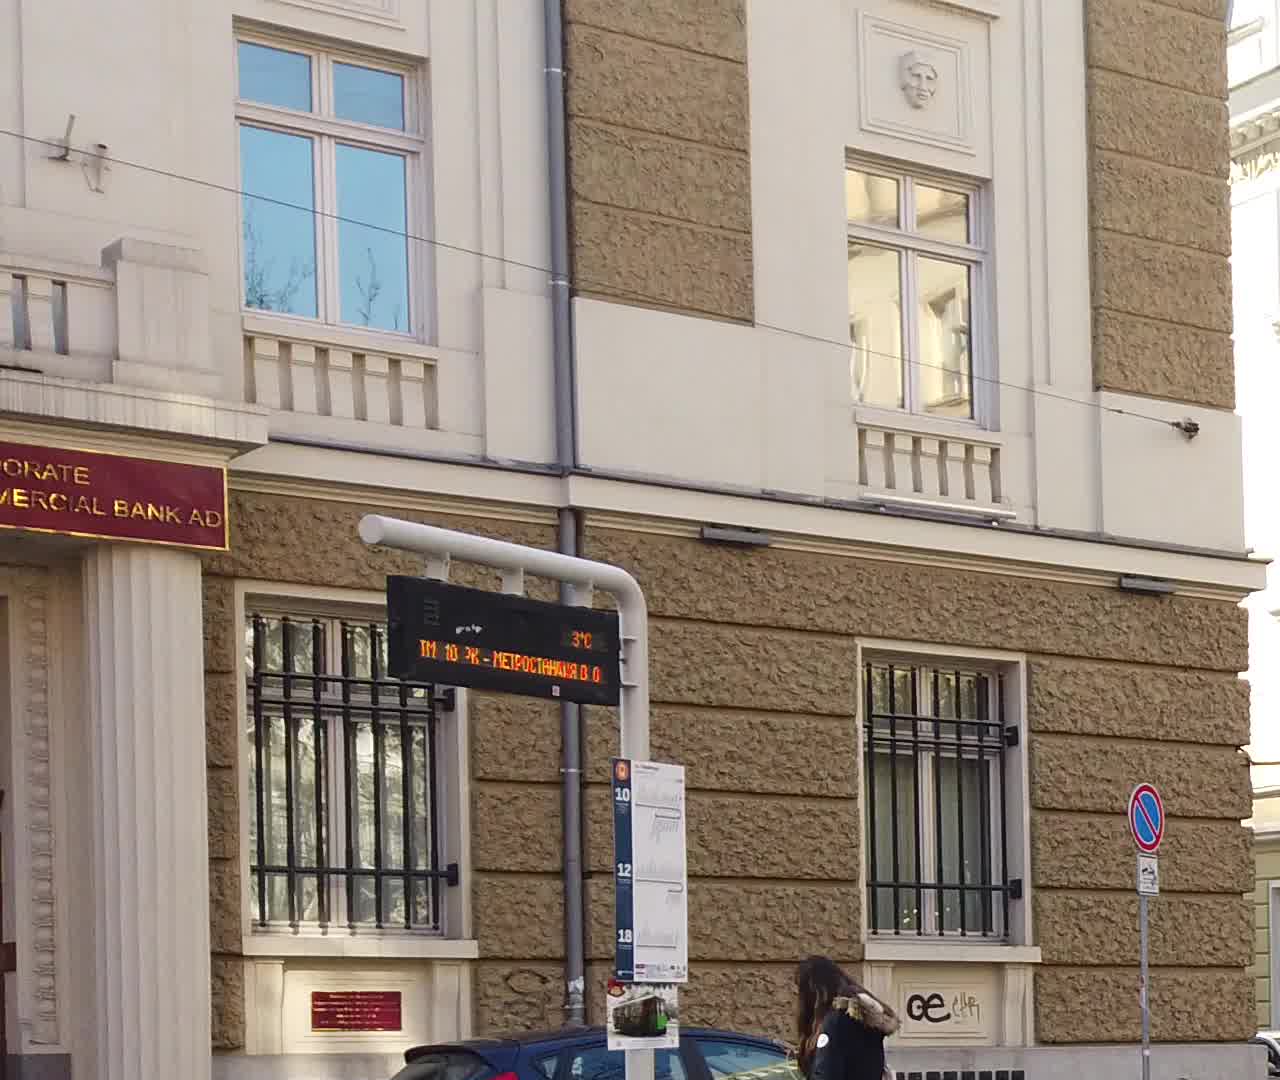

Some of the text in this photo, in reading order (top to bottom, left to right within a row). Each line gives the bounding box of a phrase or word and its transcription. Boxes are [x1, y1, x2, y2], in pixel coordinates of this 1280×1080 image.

[0, 457, 91, 486] ORATE
[113, 499, 182, 525] BANK
[188, 509, 223, 528] AD
[615, 787, 630, 802] 10
[617, 863, 632, 877] 12
[618, 929, 632, 943] 18
